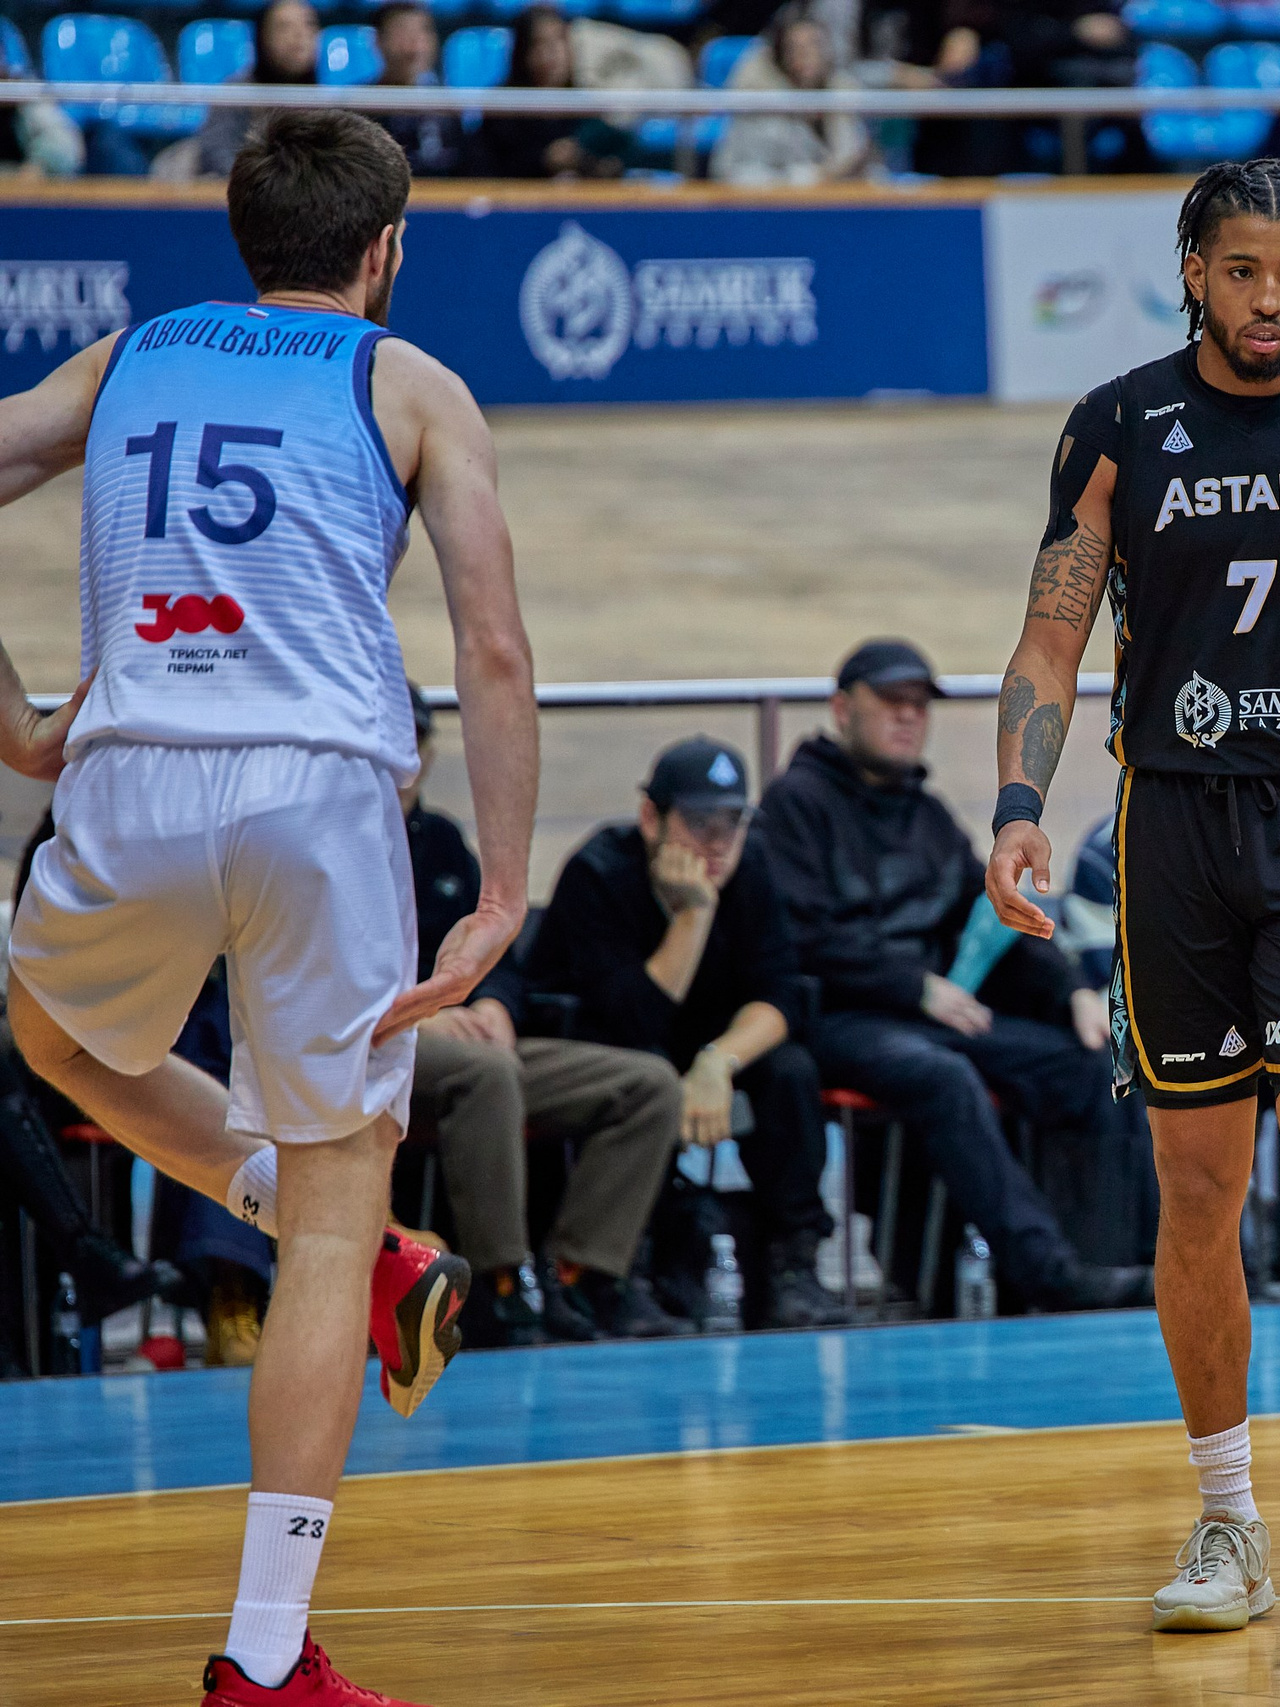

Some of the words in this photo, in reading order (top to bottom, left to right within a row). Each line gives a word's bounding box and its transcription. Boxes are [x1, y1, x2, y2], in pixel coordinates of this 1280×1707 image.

[135, 318, 348, 360] ABDULBASIROV
[125, 421, 284, 545] 15
[134, 593, 245, 643] 300
[1226, 560, 1278, 635] 7
[167, 662, 214, 673] ПЕРМИ
[169, 648, 220, 659] ТРИСТА
[223, 648, 248, 659] ЛЕТ
[287, 1515, 325, 1539] 23
